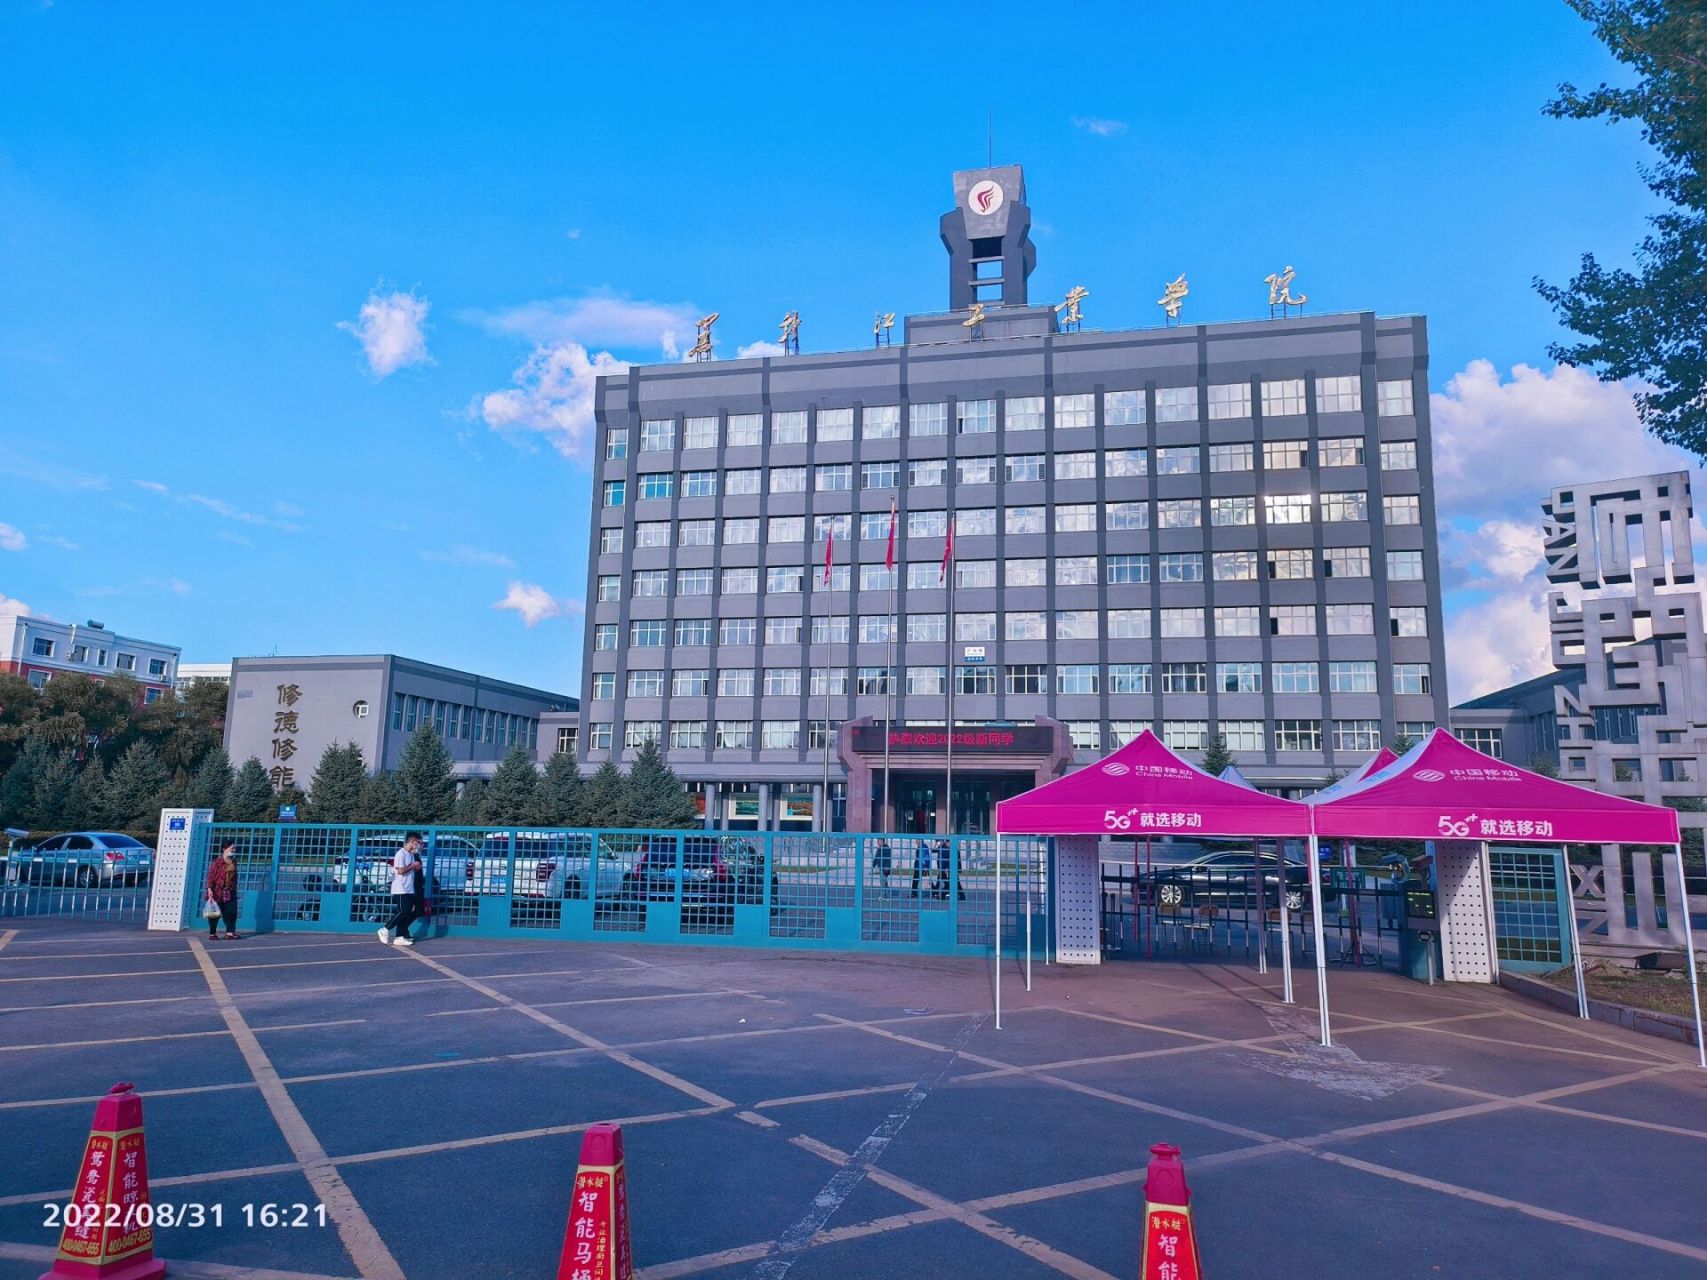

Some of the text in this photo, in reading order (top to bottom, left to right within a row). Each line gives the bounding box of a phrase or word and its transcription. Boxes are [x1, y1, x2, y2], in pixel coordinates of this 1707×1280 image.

[269, 683, 304, 788] 修德修能
[1135, 765, 1193, 776] 中国移动
[1450, 768, 1519, 777] 中国移动
[1140, 812, 1203, 828] 就选移动
[1480, 819, 1553, 836] 就选移动
[122, 1151, 139, 1234] 智能晾机
[1152, 1215, 1182, 1231] 潜水艇
